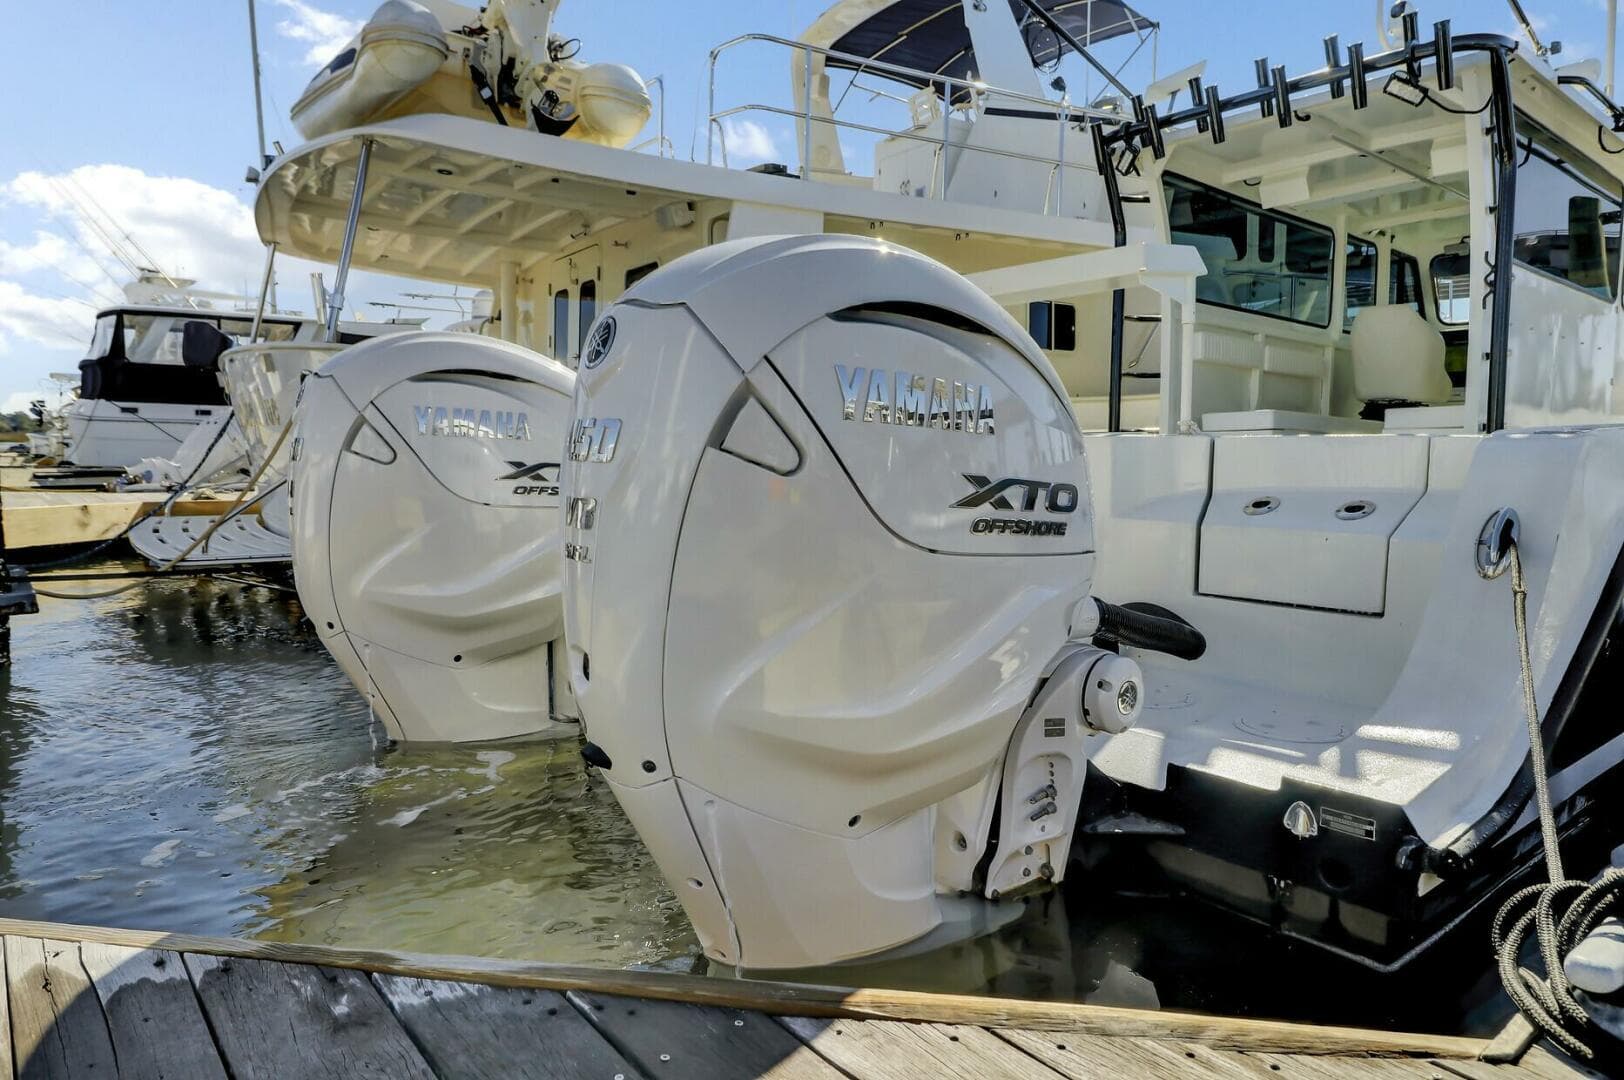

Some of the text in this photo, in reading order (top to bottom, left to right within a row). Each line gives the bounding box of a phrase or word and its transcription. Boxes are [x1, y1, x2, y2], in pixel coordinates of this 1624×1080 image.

[834, 364, 997, 436] YAMAHA
[414, 405, 532, 441] YAMAHA
[513, 485, 560, 497] OFFS
[949, 472, 1079, 513] XTO
[969, 516, 1068, 536] OFFSHORE
